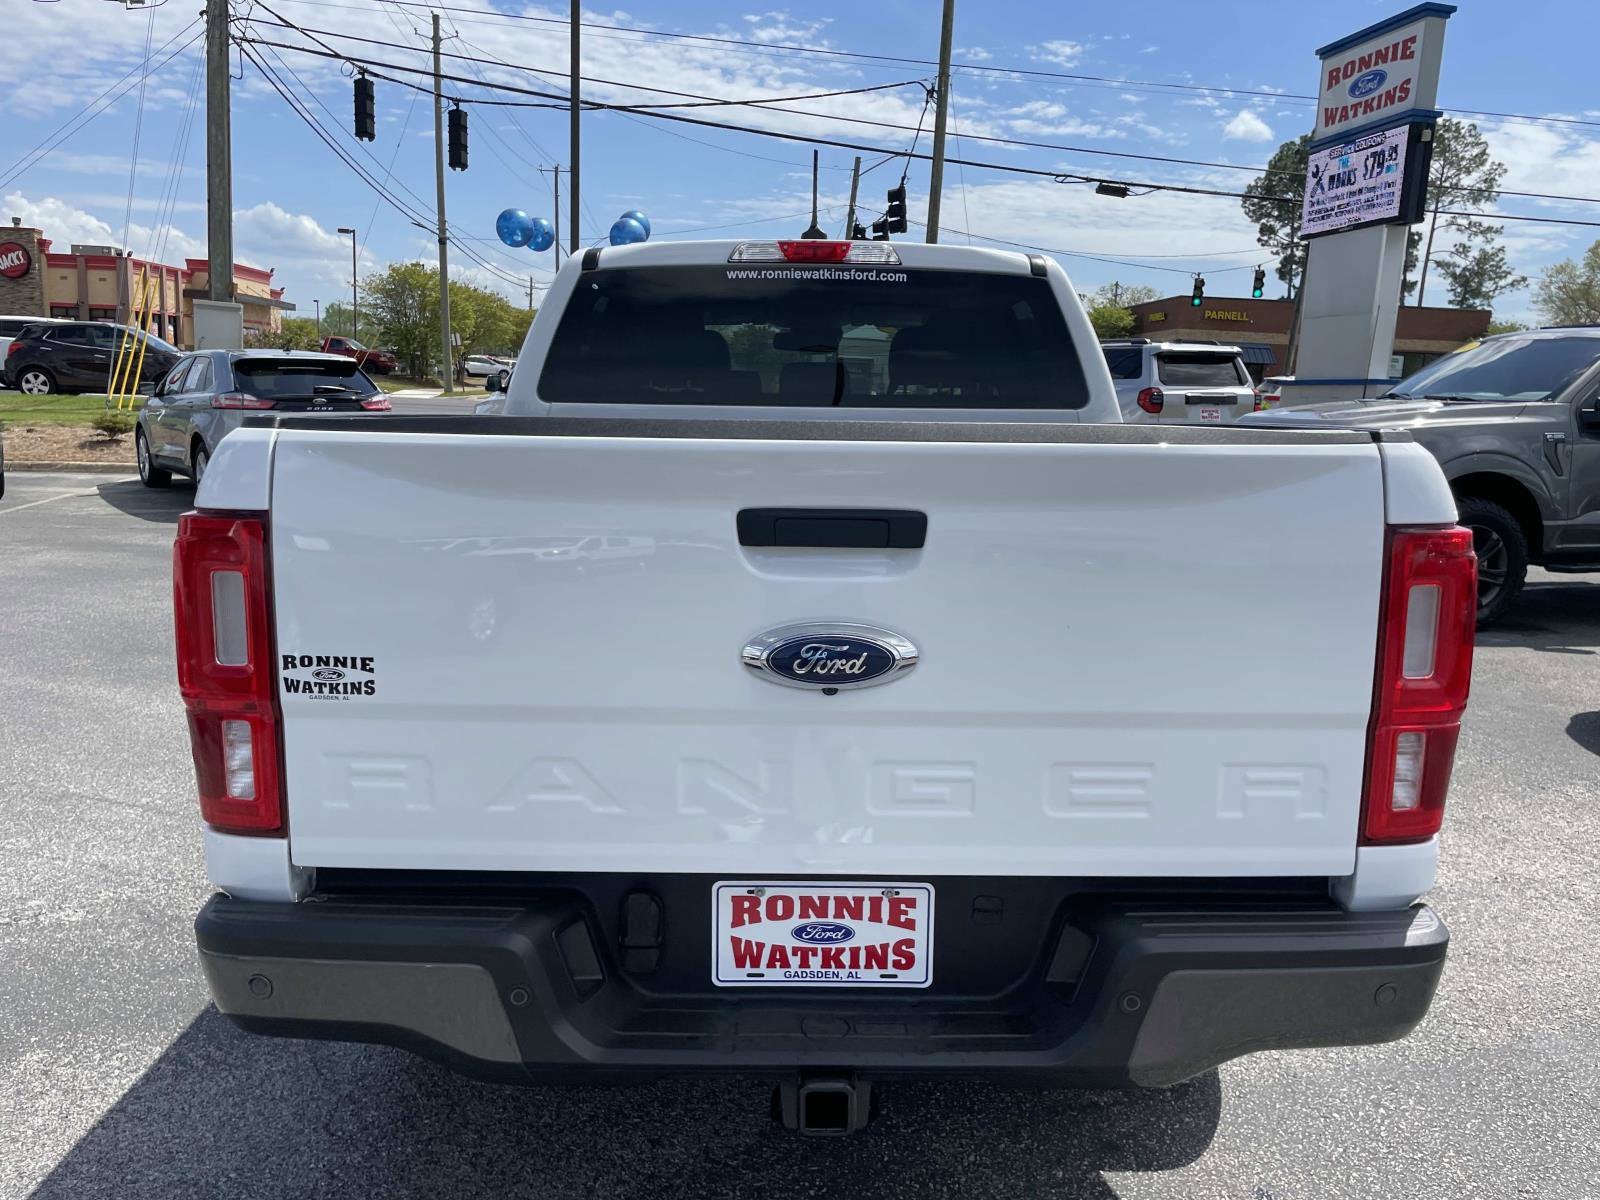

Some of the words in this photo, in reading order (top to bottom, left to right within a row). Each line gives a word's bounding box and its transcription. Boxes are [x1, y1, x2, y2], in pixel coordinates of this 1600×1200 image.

[1327, 35, 1417, 92] RONNIE
[1355, 74, 1381, 96] Ford
[1324, 78, 1412, 128] WATKINS
[726, 268, 907, 282] www.ronniewatkinsford.com
[1204, 310, 1249, 321] PARNELL
[282, 654, 375, 674] RONNIE
[793, 643, 868, 674] Ford
[283, 676, 376, 696] WATKINS
[322, 751, 1329, 820] RANGER
[730, 894, 917, 931] RONNIE
[802, 924, 847, 939] Ford
[730, 935, 917, 971] WATKINS
[784, 970, 843, 981] GADSDEN,
[846, 970, 861, 980] AL
